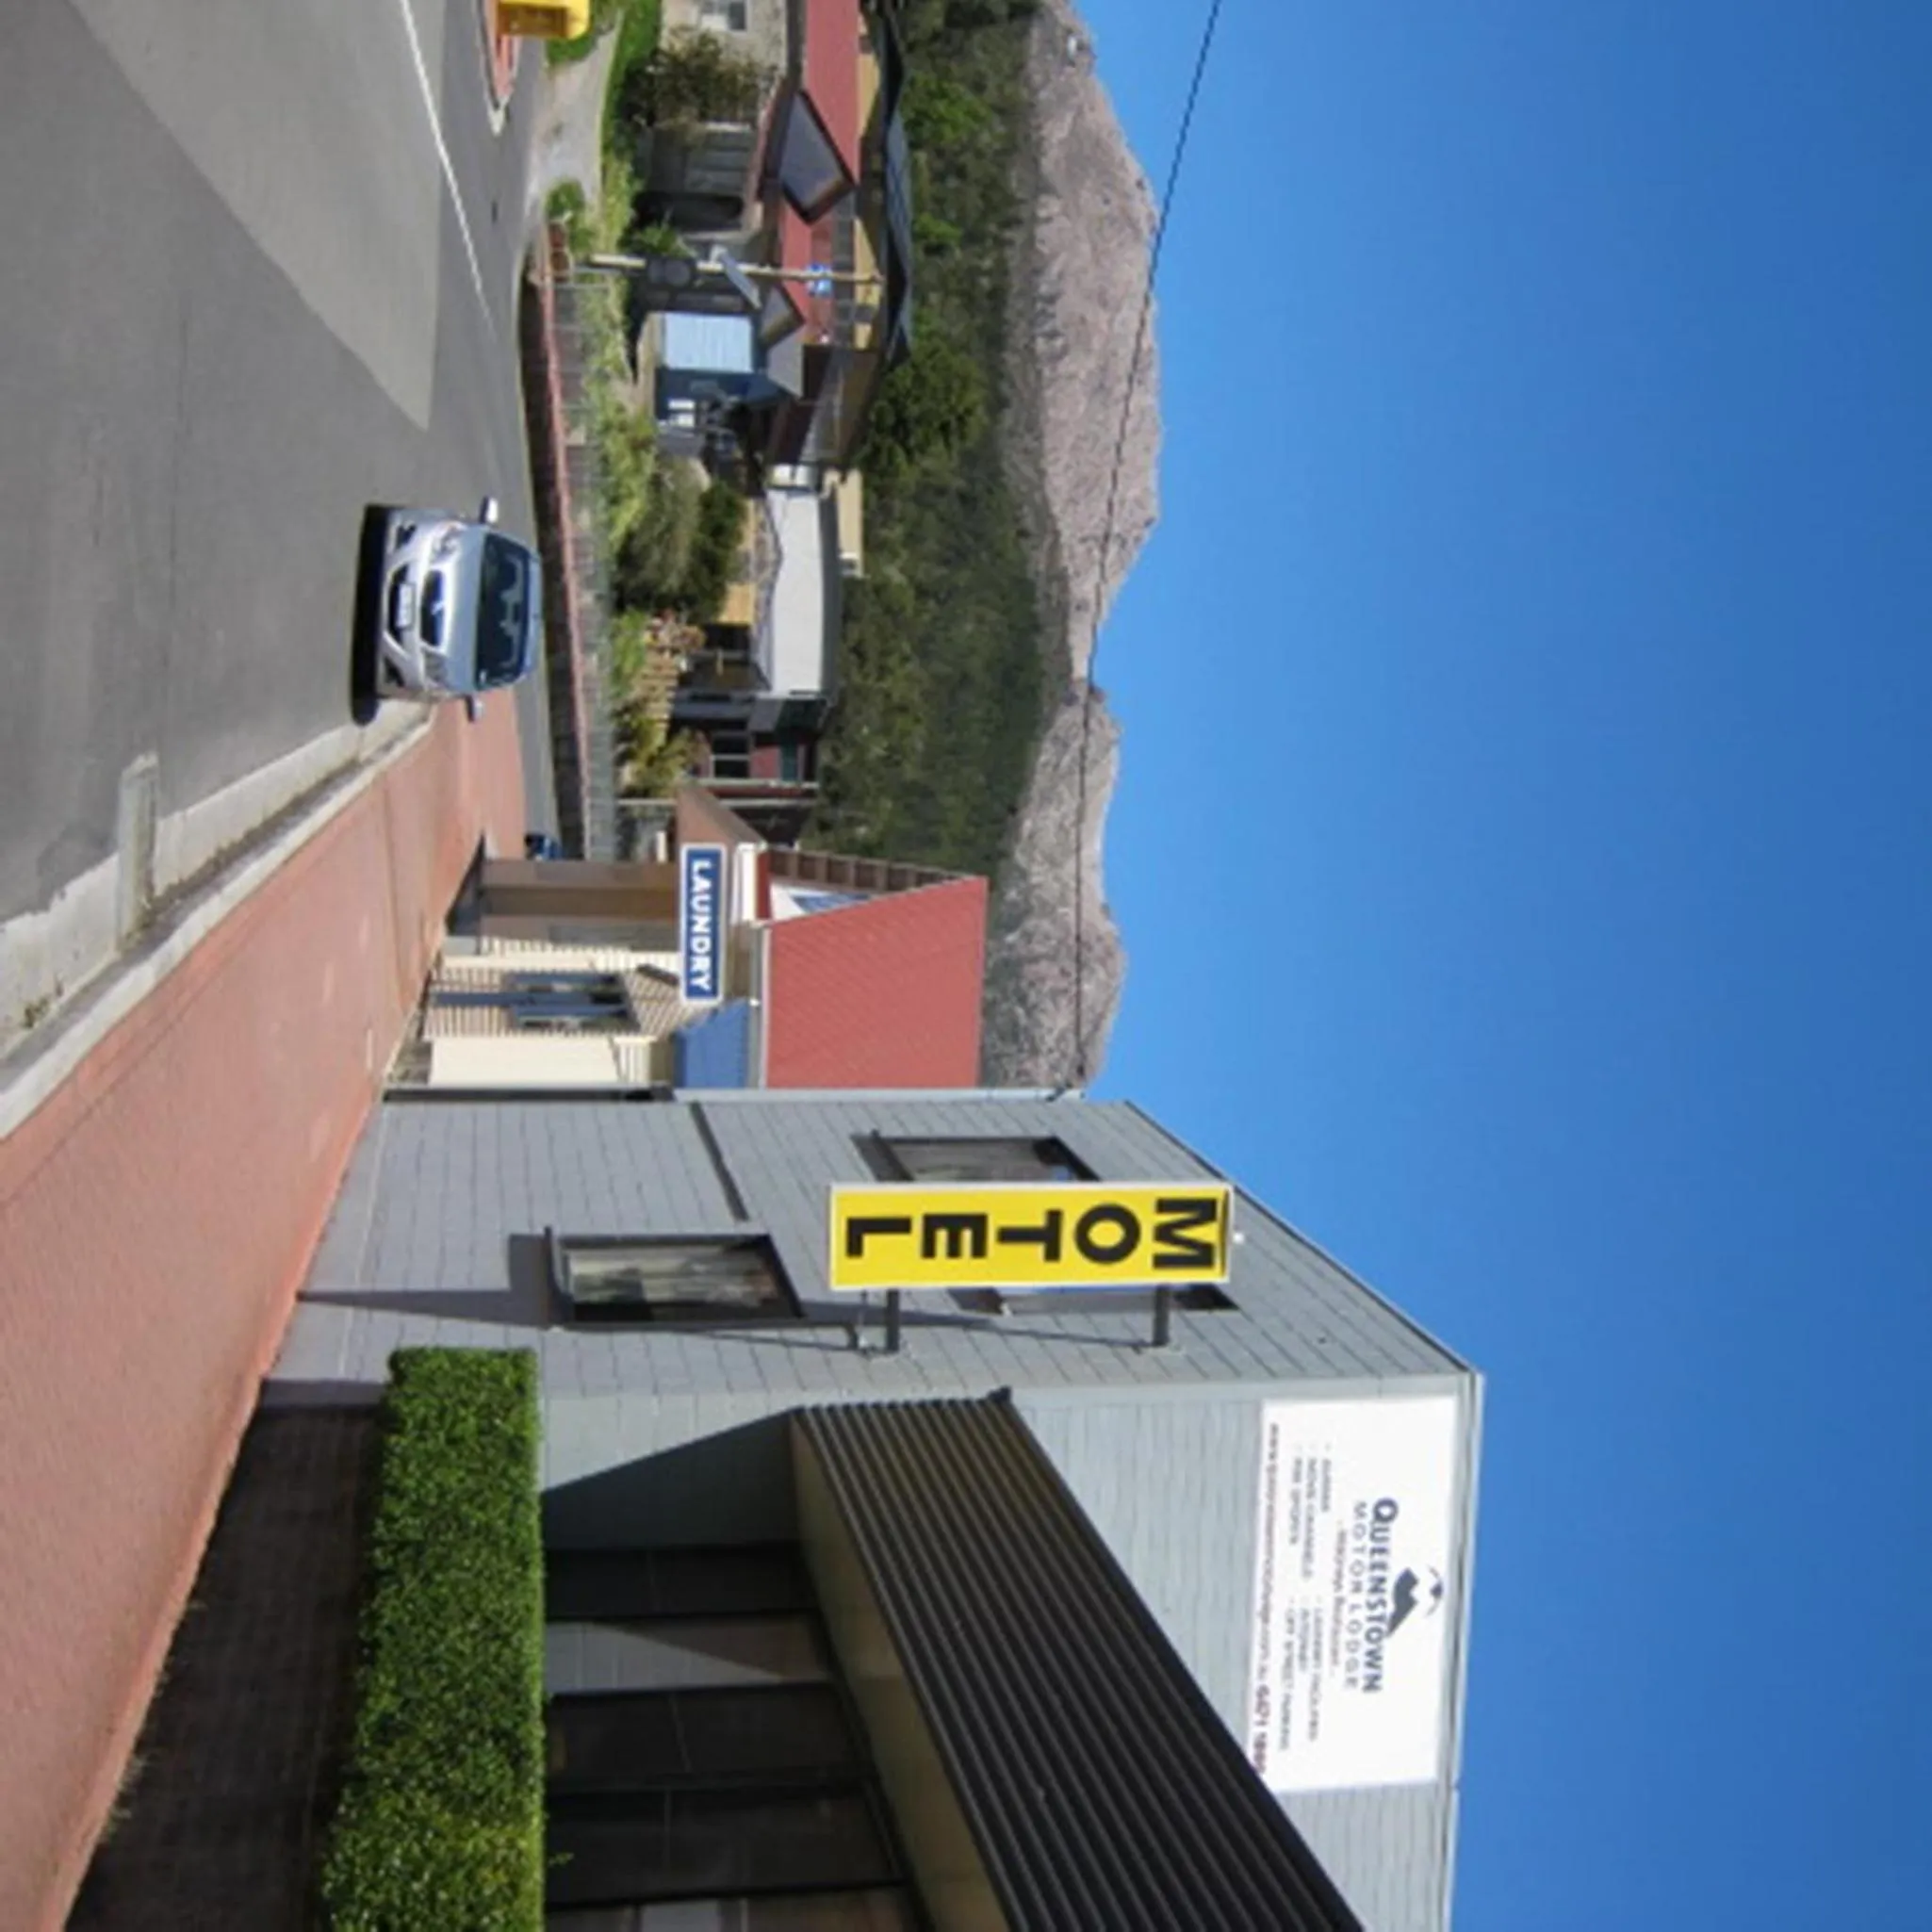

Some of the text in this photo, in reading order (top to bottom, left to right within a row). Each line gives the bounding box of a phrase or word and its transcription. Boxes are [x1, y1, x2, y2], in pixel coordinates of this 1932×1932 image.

[690, 859, 712, 991] LAUNDRY
[845, 1197, 1219, 1270] MOTEL
[1344, 1500, 1368, 1690] MOTOR LODGE
[1362, 1496, 1400, 1695] QUEENSTOWN
